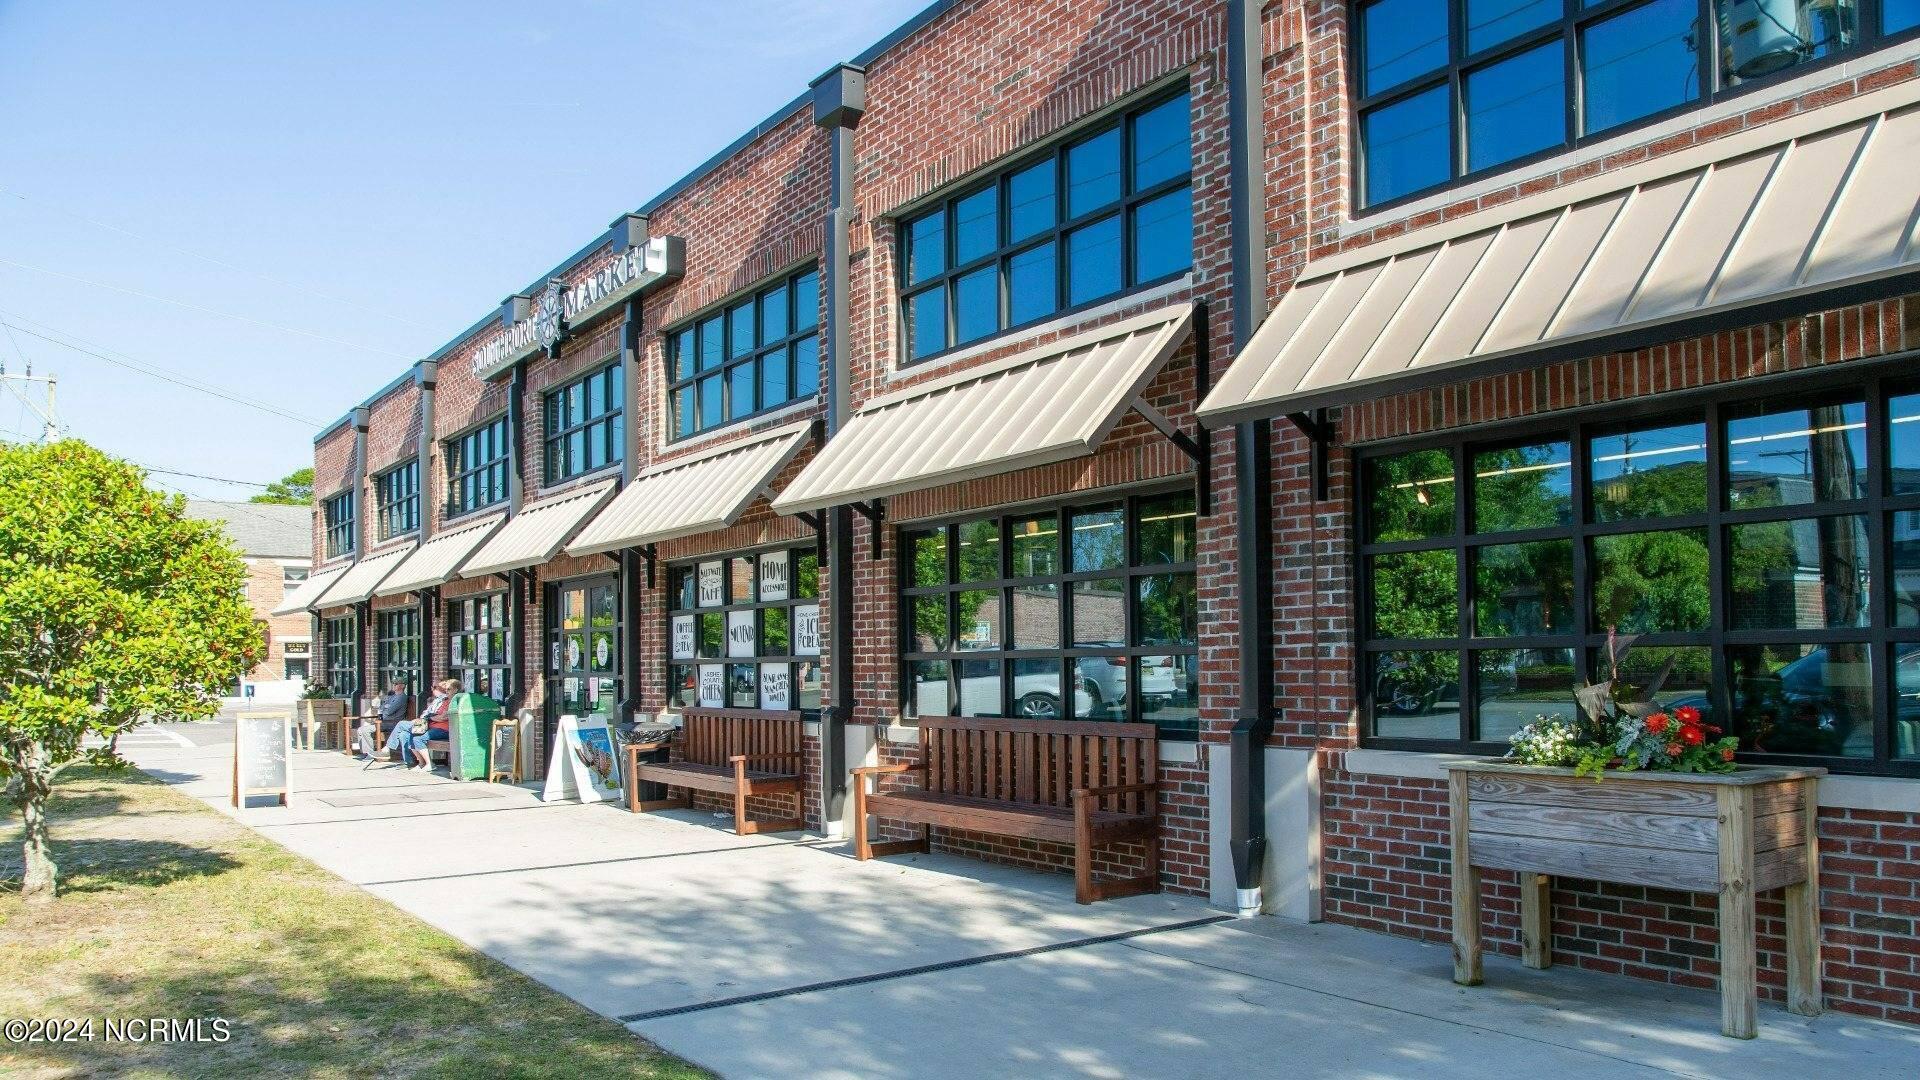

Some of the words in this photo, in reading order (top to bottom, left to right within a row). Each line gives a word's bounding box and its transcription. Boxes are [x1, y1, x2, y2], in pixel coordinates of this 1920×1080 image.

[563, 240, 651, 319] MARKET
[730, 625, 755, 643] SOUVENIR
[802, 635, 820, 648] CREA
